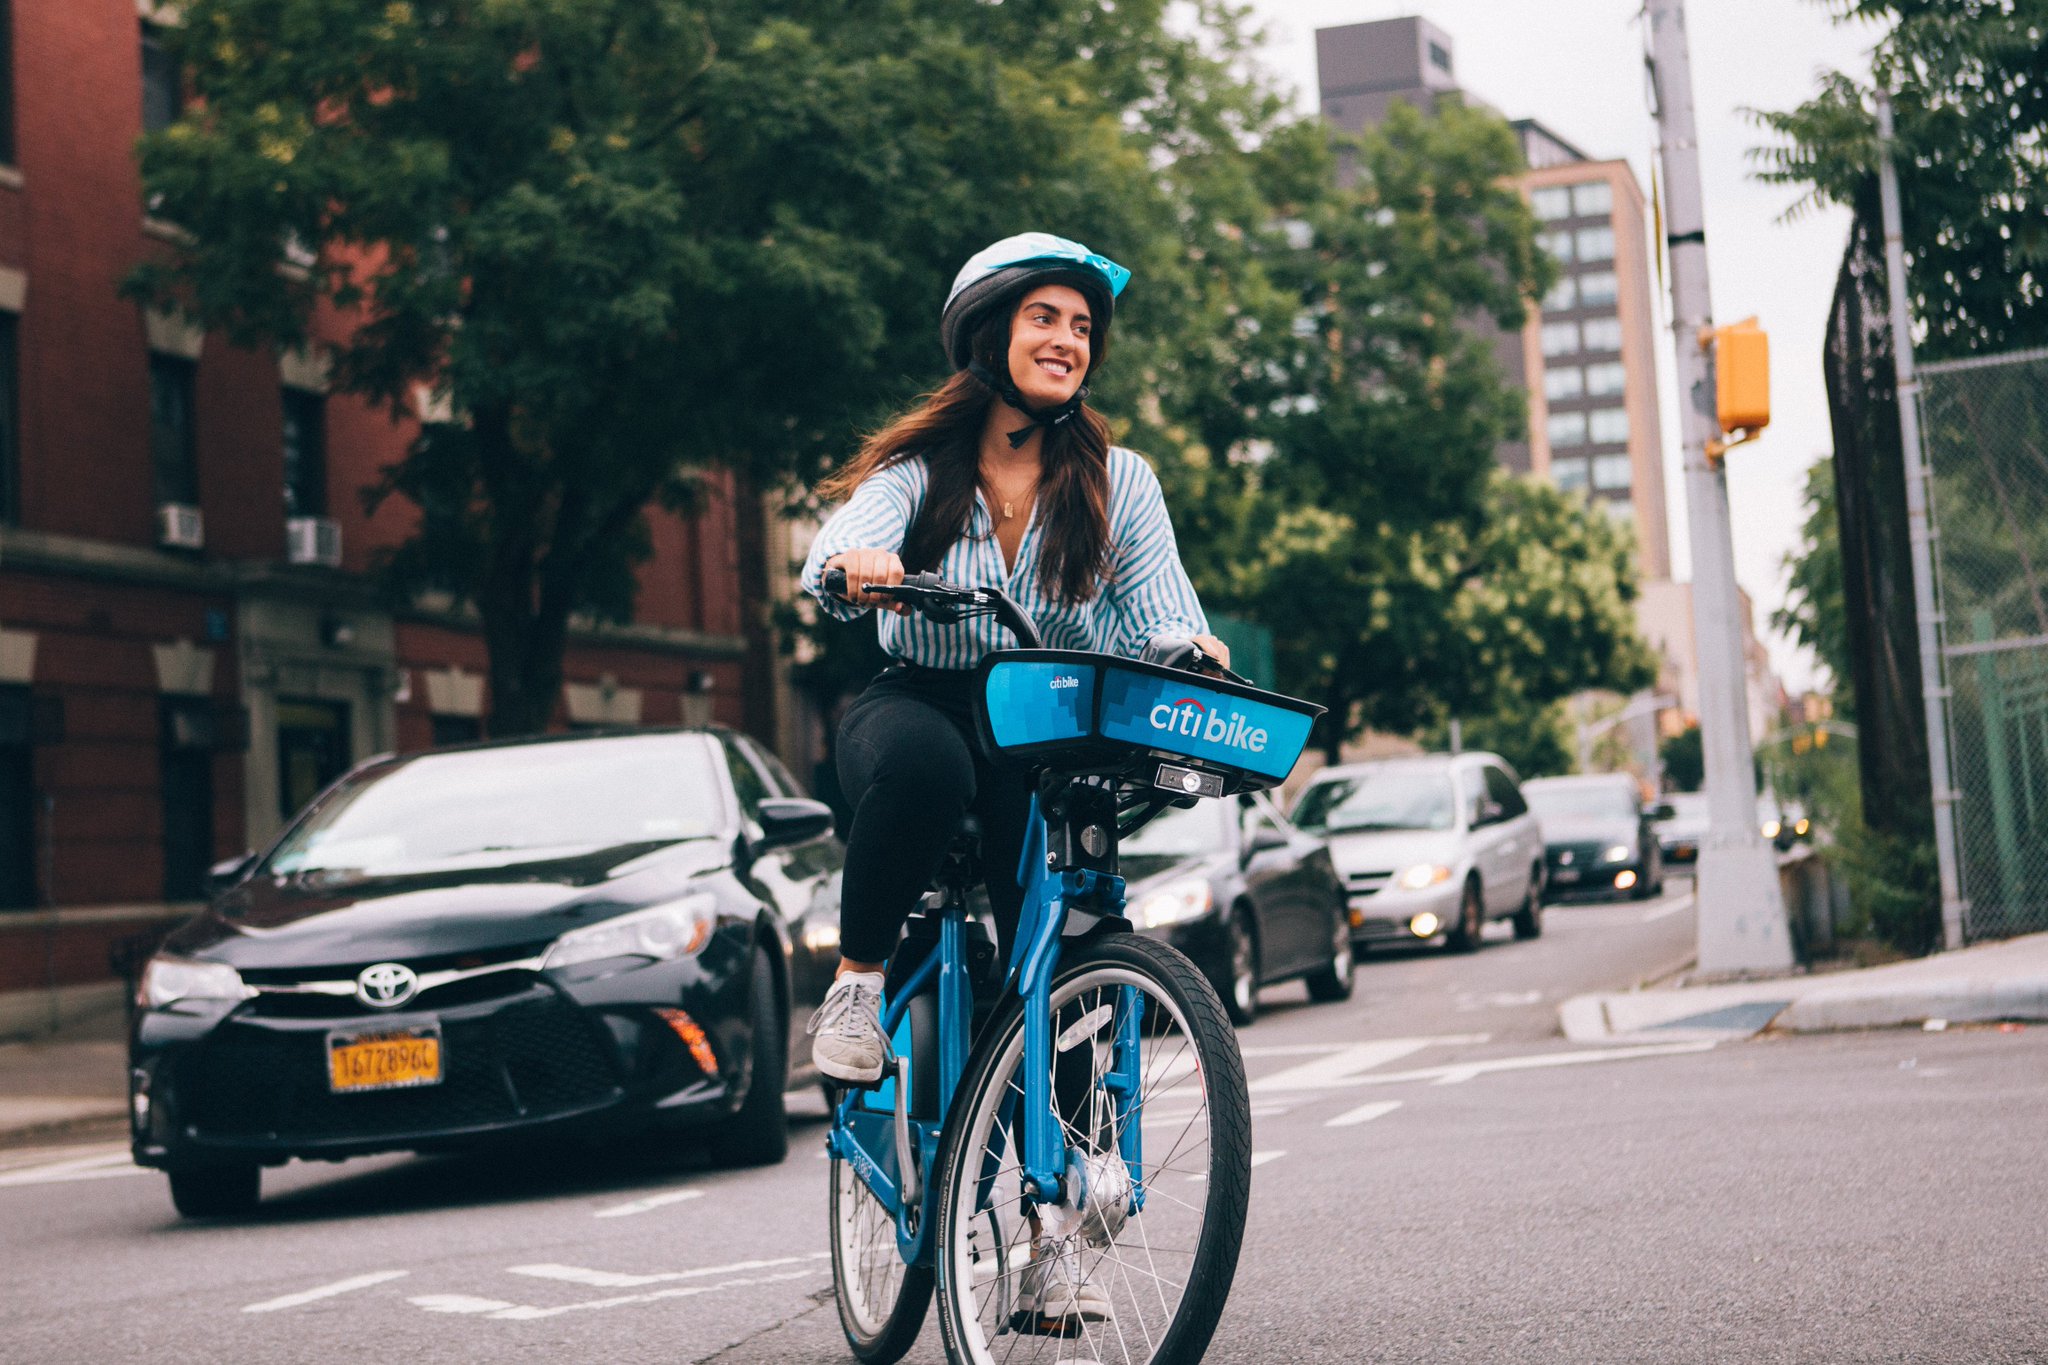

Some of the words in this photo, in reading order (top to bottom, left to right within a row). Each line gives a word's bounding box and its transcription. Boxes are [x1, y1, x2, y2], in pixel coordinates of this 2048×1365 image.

[1062, 676, 1079, 688] bike
[1150, 703, 1202, 738] citi
[1203, 708, 1268, 753] bike
